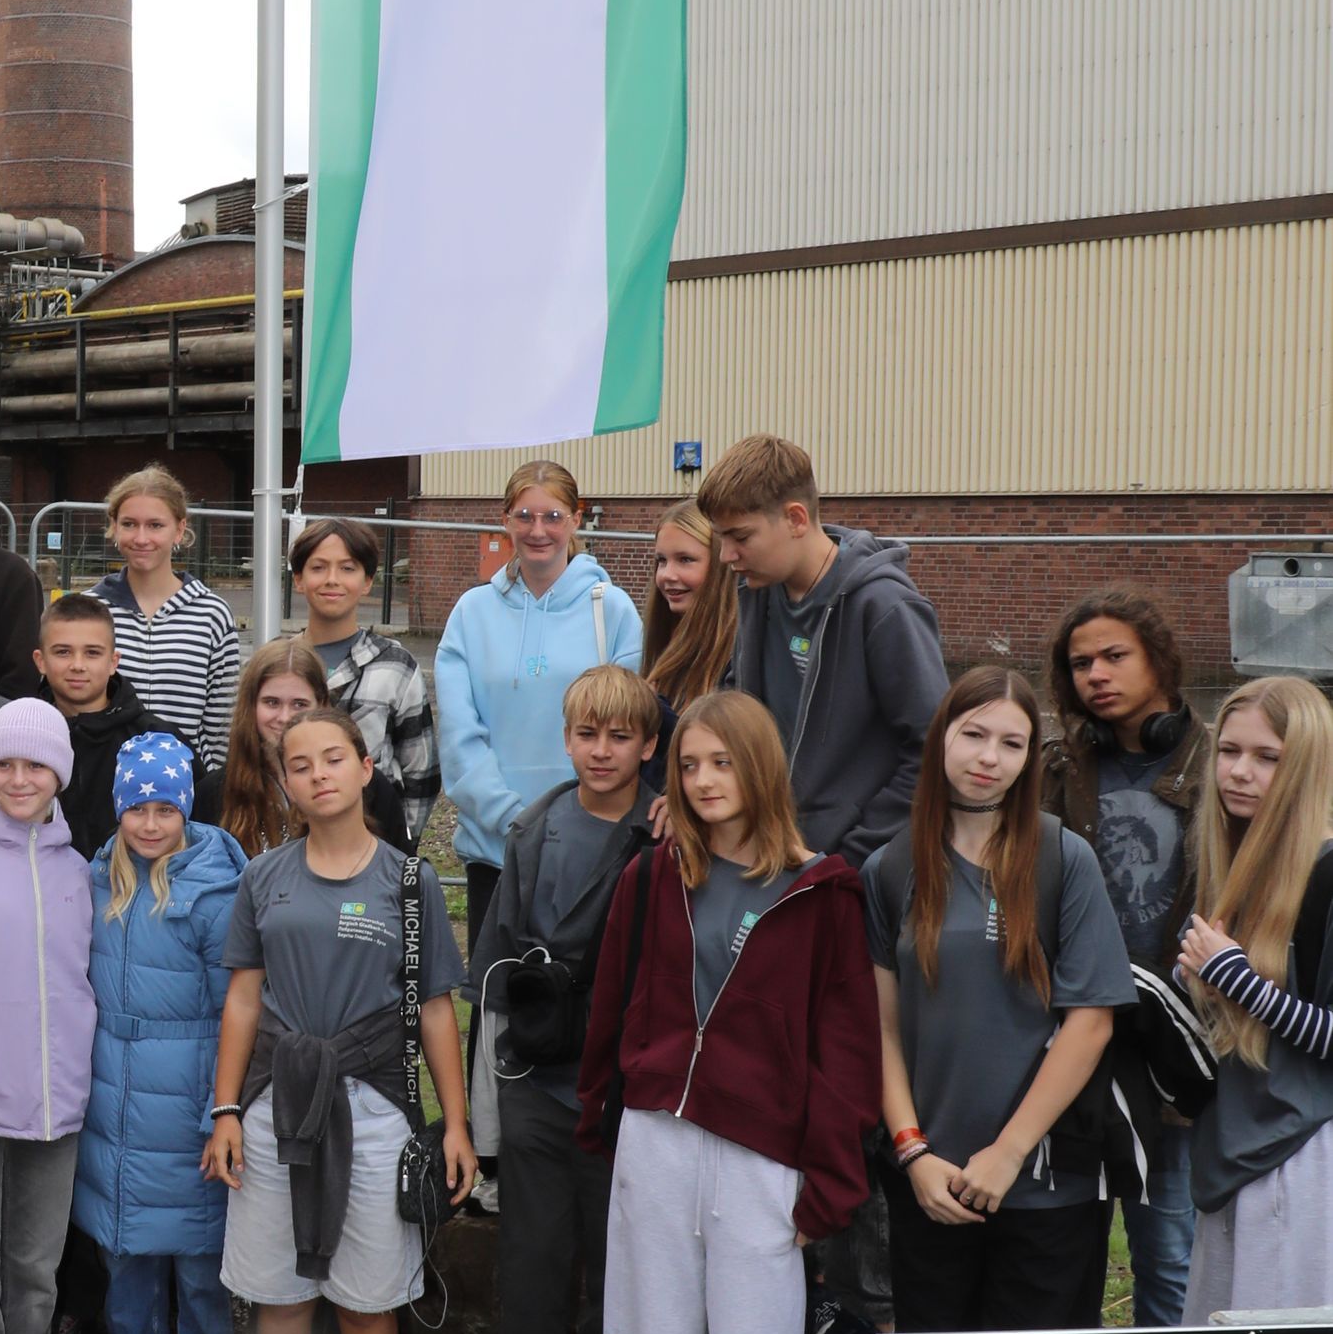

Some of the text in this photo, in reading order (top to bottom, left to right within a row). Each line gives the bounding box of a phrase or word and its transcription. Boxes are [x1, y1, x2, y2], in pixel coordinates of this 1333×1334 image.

[403, 856, 420, 886] ORS
[404, 899, 420, 975] MICHAEL
[406, 979, 418, 1027] KORS
